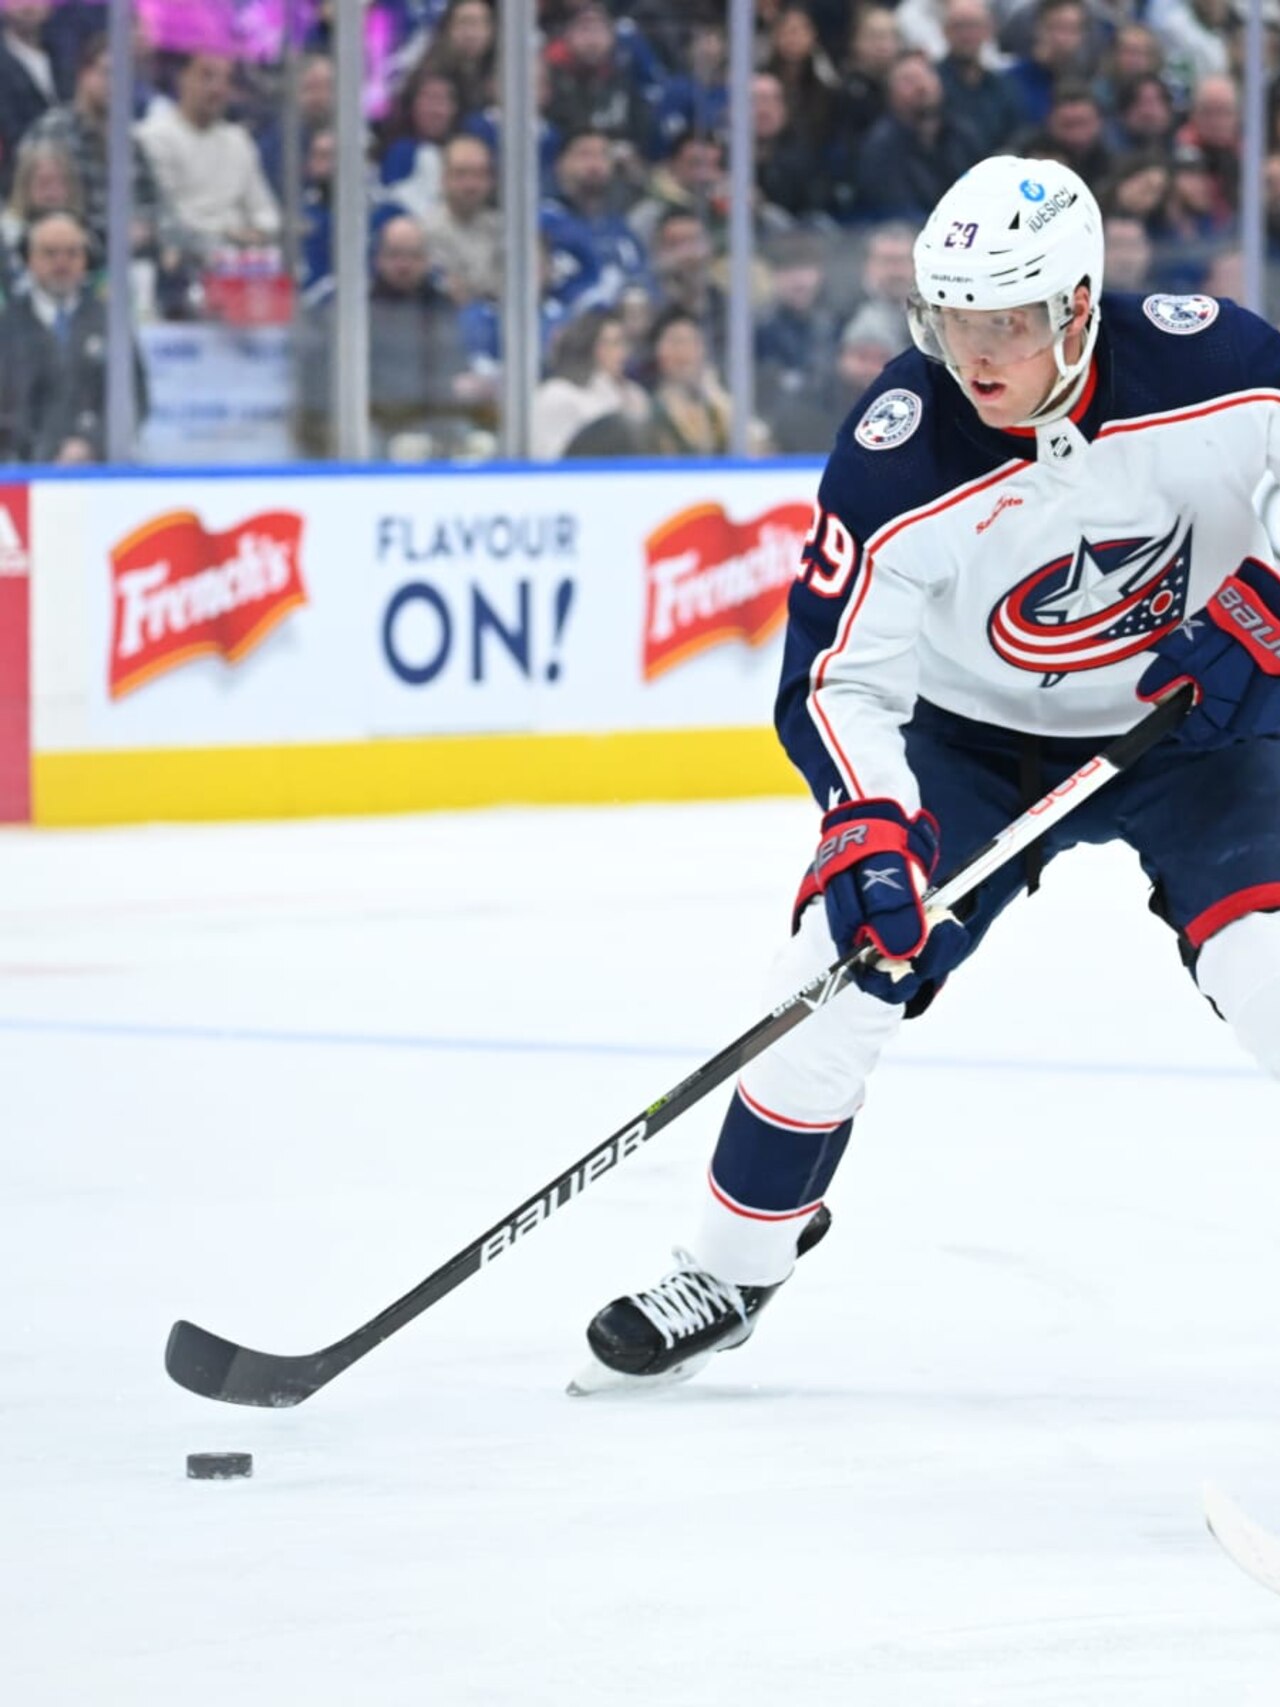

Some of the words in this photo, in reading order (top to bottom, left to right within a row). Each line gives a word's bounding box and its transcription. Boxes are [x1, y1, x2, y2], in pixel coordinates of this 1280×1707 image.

[944, 221, 979, 249] 29
[376, 514, 578, 563] FLAVOUR
[381, 575, 575, 687] ON!
[480, 1119, 648, 1268] BAUER
